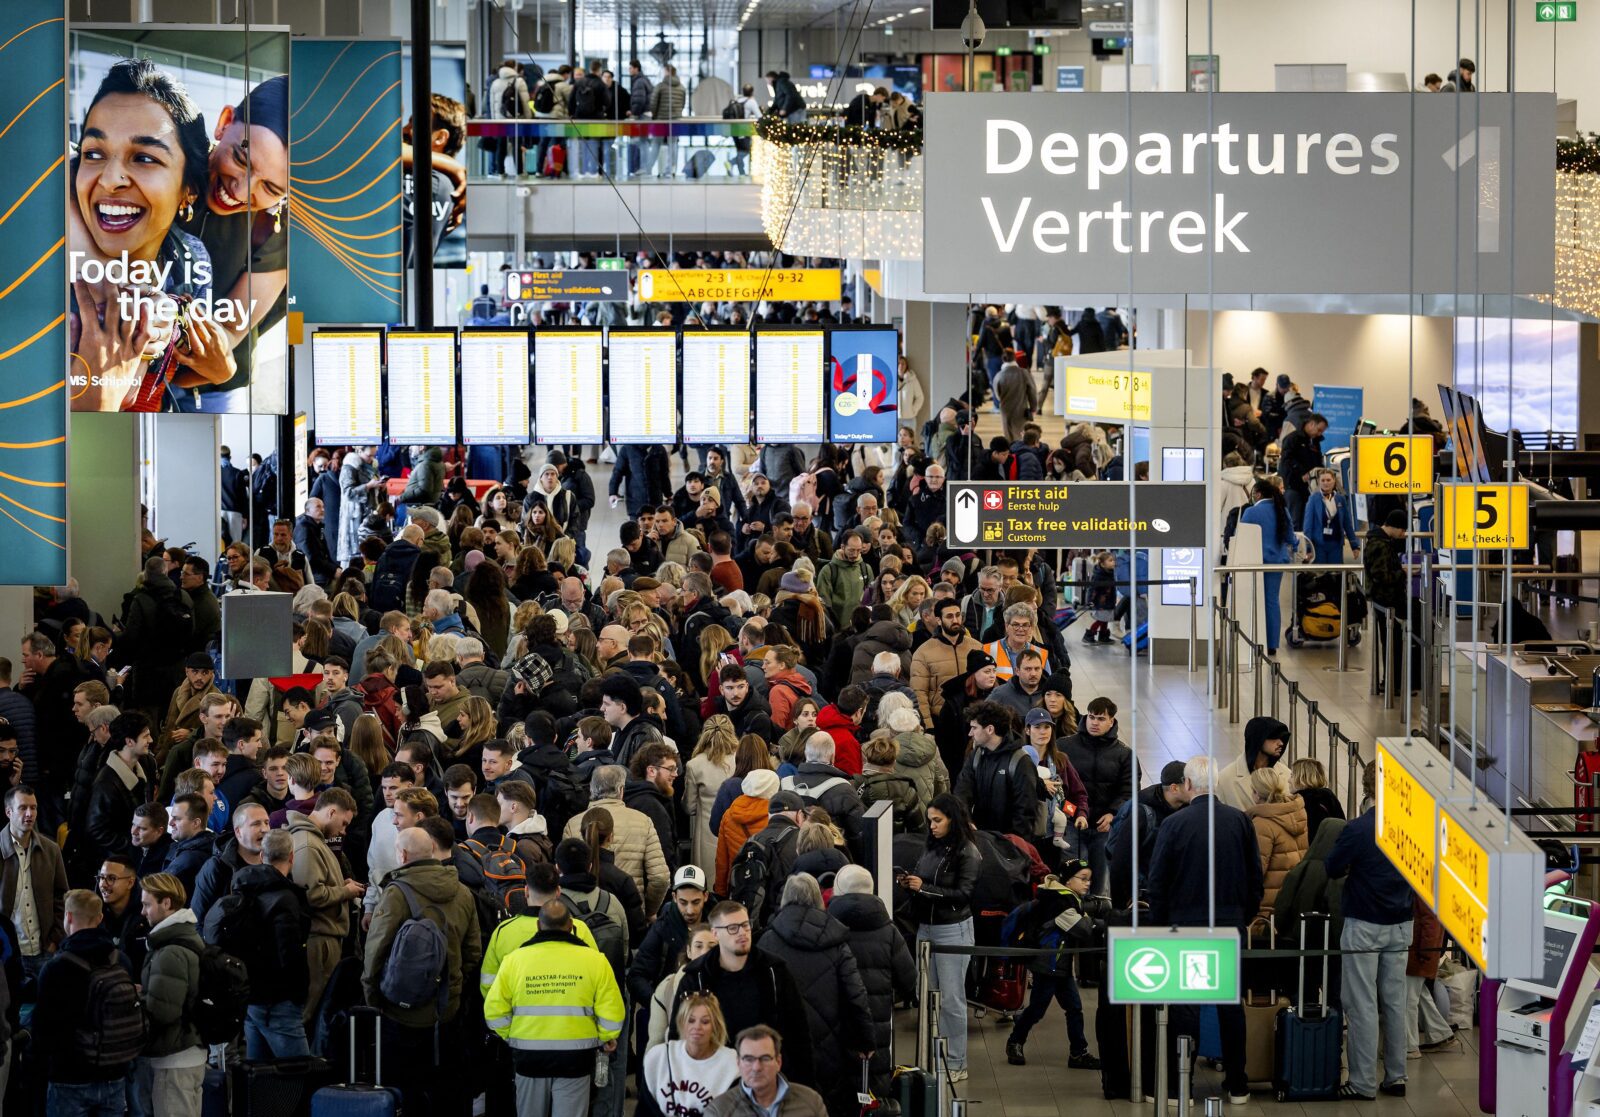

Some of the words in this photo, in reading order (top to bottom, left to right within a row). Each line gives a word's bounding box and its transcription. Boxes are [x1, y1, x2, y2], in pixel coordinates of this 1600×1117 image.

[985, 118, 1400, 190] Departures
[1441, 126, 1500, 253] 1
[981, 193, 1251, 254] Vertrek
[69, 249, 173, 292] Today
[184, 251, 212, 285] is
[706, 273, 724, 283] 2-3
[777, 272, 804, 283] 9-32
[117, 288, 178, 322] the
[189, 288, 258, 331] day
[91, 375, 142, 388] Schiphol
[1113, 375, 1120, 390] 6
[1123, 376, 1129, 391] 7
[1133, 377, 1139, 392] 8
[1383, 441, 1407, 476] 6
[1383, 480, 1421, 489] Checkin
[1007, 487, 1040, 500] First
[1043, 486, 1068, 500] aid
[1007, 501, 1036, 511] Eerste
[1038, 501, 1060, 512] hulp
[1475, 490, 1498, 530] 5
[1007, 518, 1032, 531] Tax
[1036, 517, 1067, 531] free
[1072, 517, 1147, 531] validation
[1007, 533, 1047, 542] Customs
